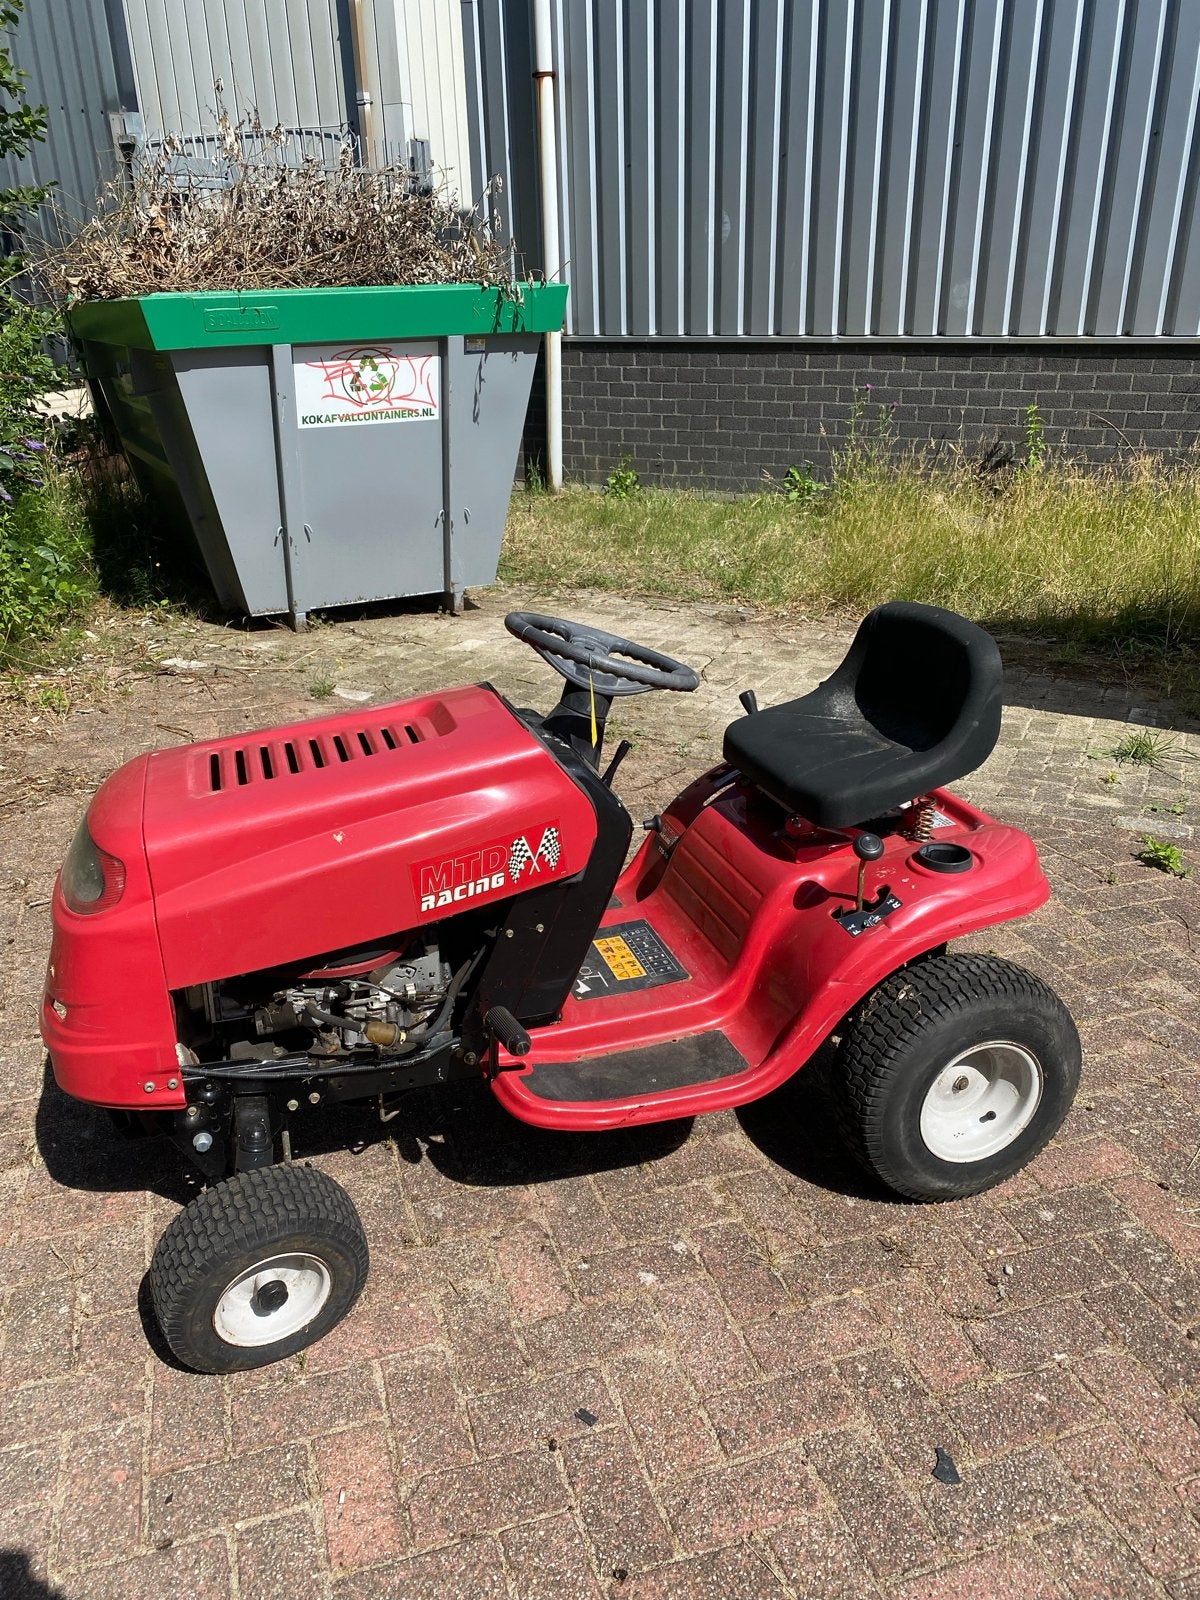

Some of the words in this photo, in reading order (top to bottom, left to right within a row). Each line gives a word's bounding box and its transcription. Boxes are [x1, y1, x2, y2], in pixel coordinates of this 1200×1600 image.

[301, 408, 435, 425] KOKAFVALCONTAINERS.NL
[421, 846, 507, 896] MTD
[892, 901, 901, 909] R
